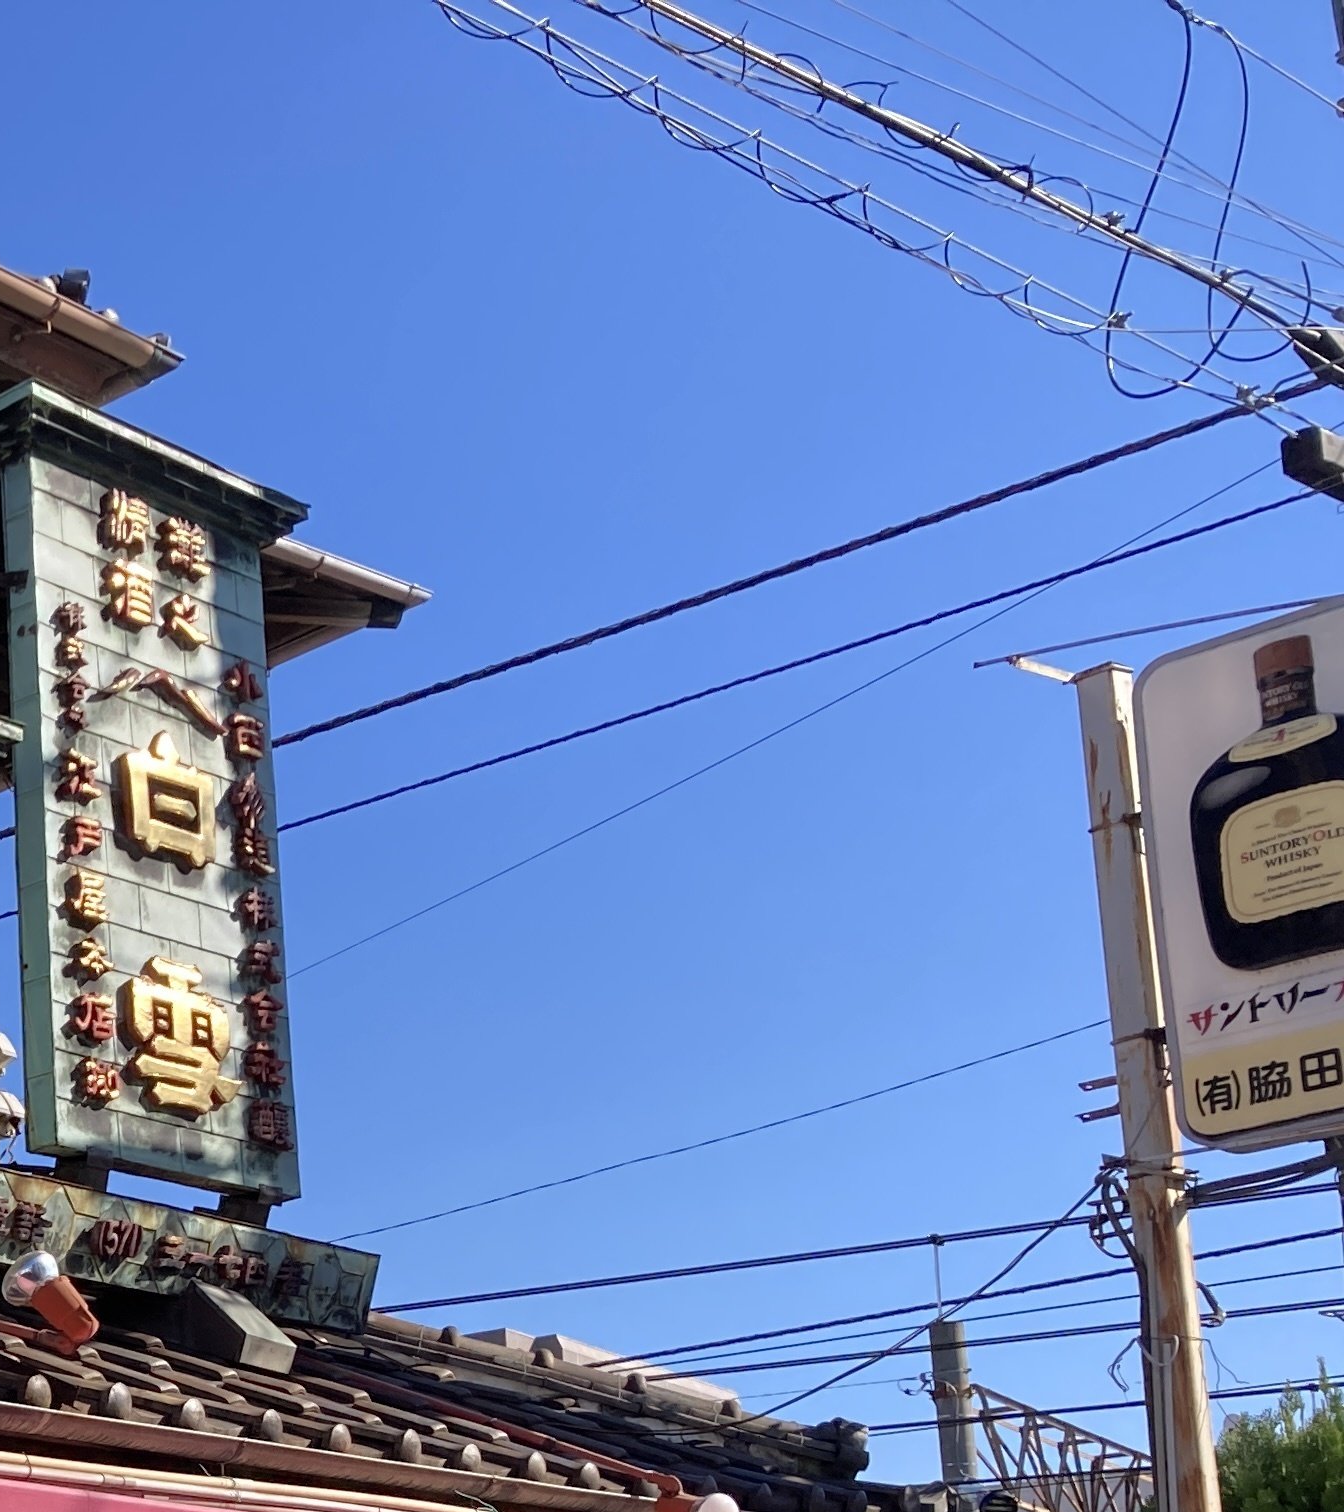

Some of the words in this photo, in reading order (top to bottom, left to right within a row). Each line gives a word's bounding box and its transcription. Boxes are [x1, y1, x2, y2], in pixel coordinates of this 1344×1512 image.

[111, 488, 155, 627] 清酒
[1240, 833, 1312, 864] SUNTORY
[1264, 845, 1321, 868] WHISKY
[126, 731, 244, 1115] 白雪
